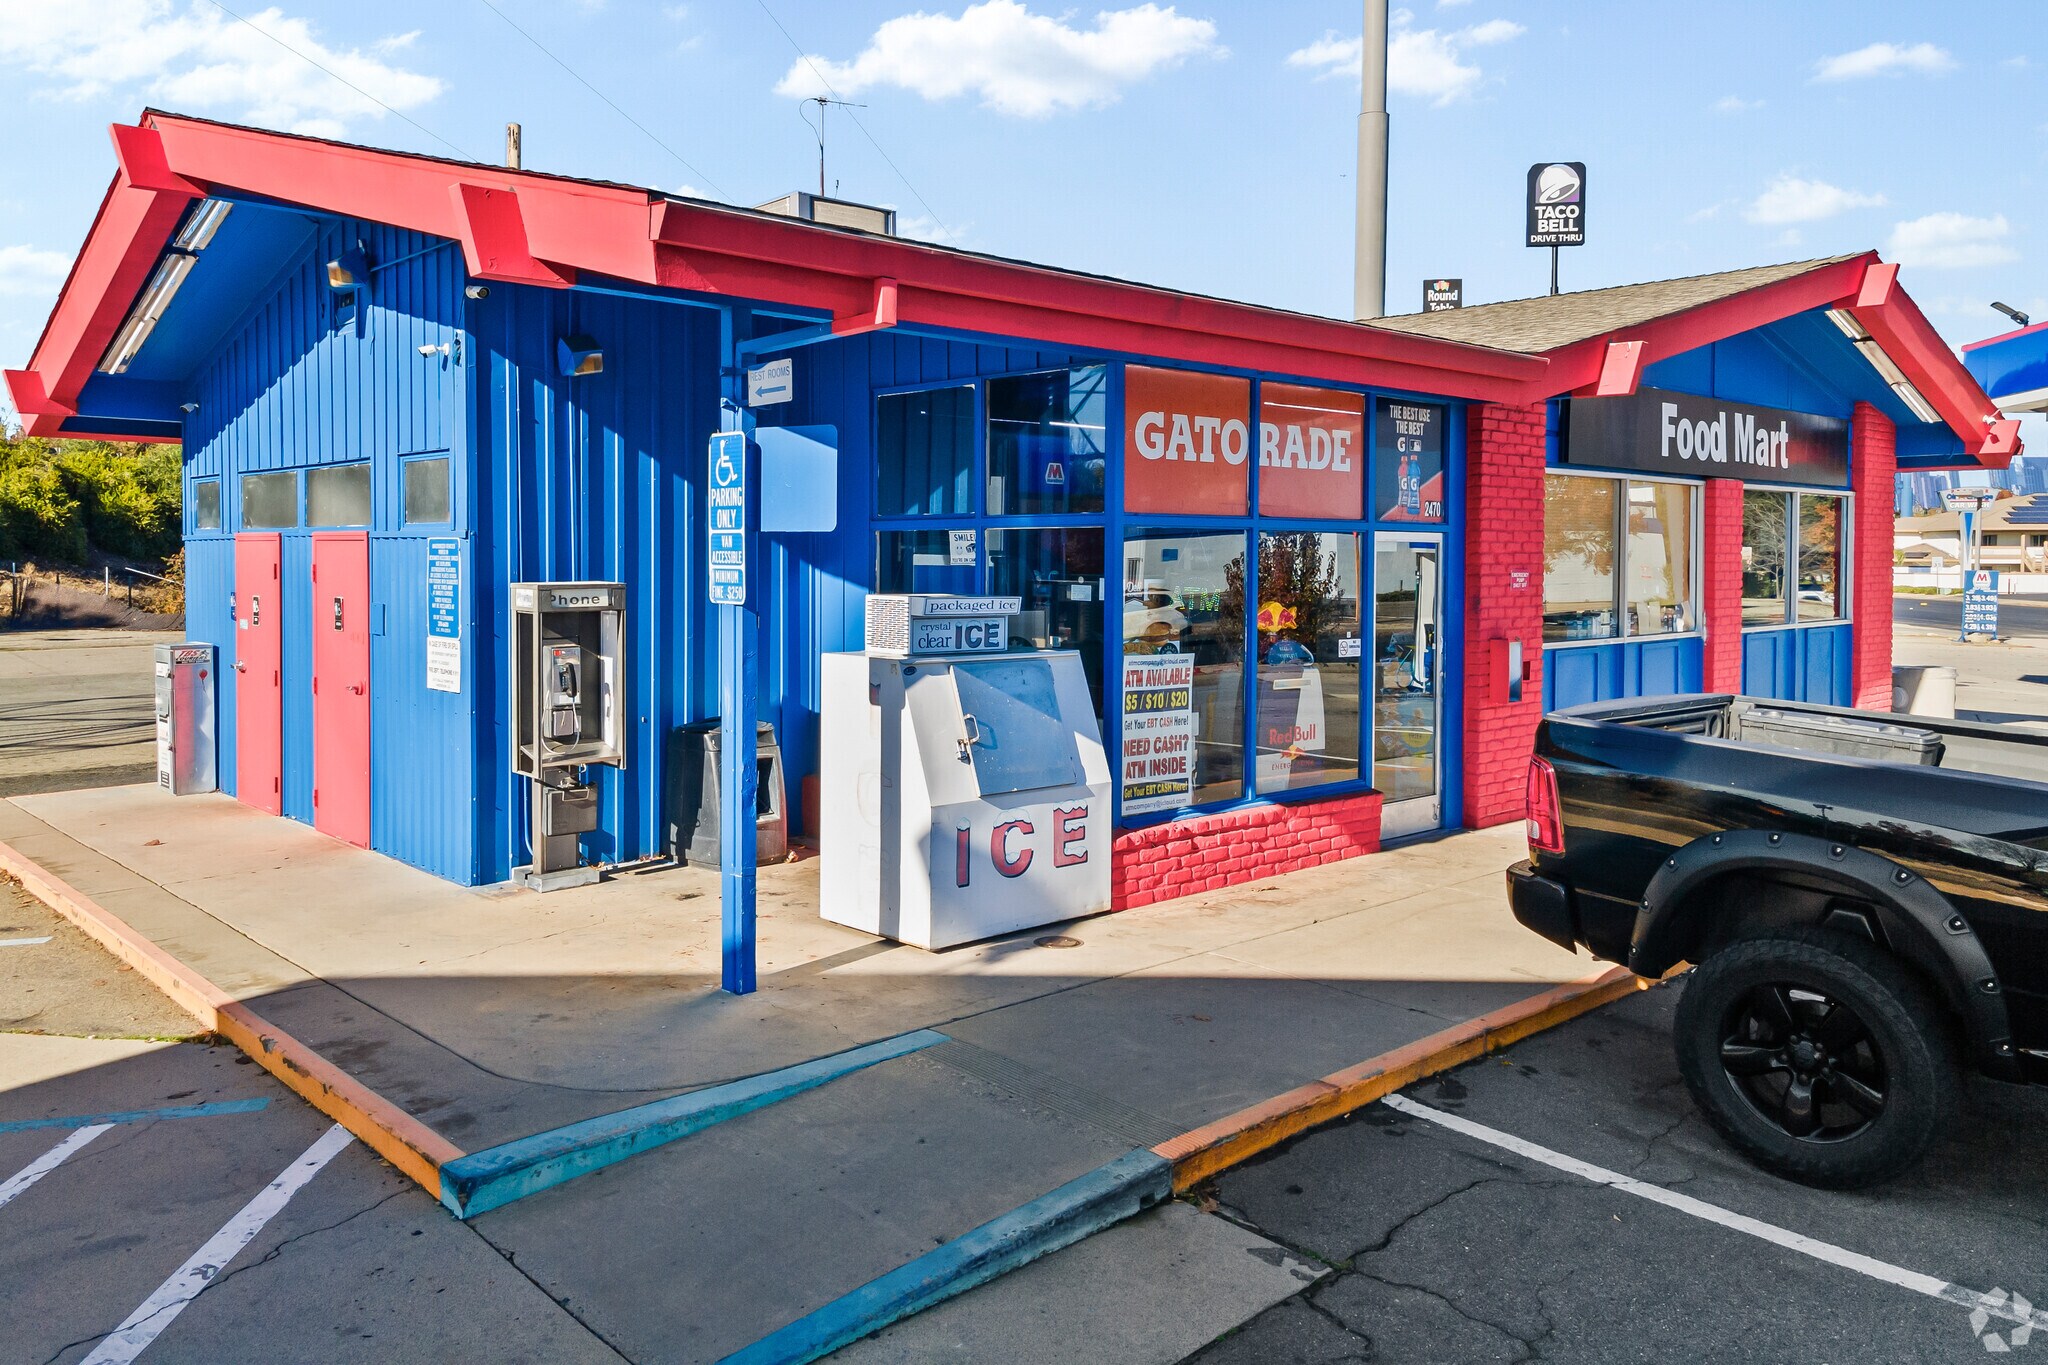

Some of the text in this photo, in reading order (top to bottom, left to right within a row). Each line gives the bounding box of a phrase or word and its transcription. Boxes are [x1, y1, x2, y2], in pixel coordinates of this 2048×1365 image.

[1534, 205, 1579, 219] TACO
[1538, 219, 1578, 232] BELL
[1530, 234, 1583, 242] DRIVE THRU
[1428, 290, 1458, 301] Round
[750, 366, 790, 381] REST ROOMS
[1390, 405, 1430, 422] THE BEST USE
[1396, 420, 1424, 435] THE BEST
[1135, 411, 1350, 472] GATORADE
[1661, 402, 1789, 469] Food Mart
[712, 487, 742, 507] PARKING
[1424, 502, 1440, 516] 2470
[717, 509, 736, 528] ONLY
[722, 535, 732, 548] VAN
[712, 551, 742, 564] ACCESSIBLE
[715, 570, 739, 583] MINIMUM
[712, 586, 742, 600] FINE $250
[1168, 586, 1220, 611] ATM
[930, 600, 1016, 613] packaged ice
[920, 622, 951, 632] crystal
[954, 620, 1000, 649] ICE
[918, 634, 952, 648] clear
[1125, 668, 1190, 687] ATM AVAILABLE
[1126, 694, 1138, 711] $5
[1140, 694, 1144, 710] /
[1146, 693, 1164, 710] $10
[1171, 691, 1187, 708] $20
[1124, 715, 1188, 730] Get Your EBT CASH Here!
[1269, 724, 1316, 745] Red Bull
[1124, 738, 1150, 757] NEED
[1125, 756, 1186, 779] ATM INSIDE
[1124, 781, 1188, 798] Get Your EBT CASH Here!
[956, 800, 1088, 888] ICE
